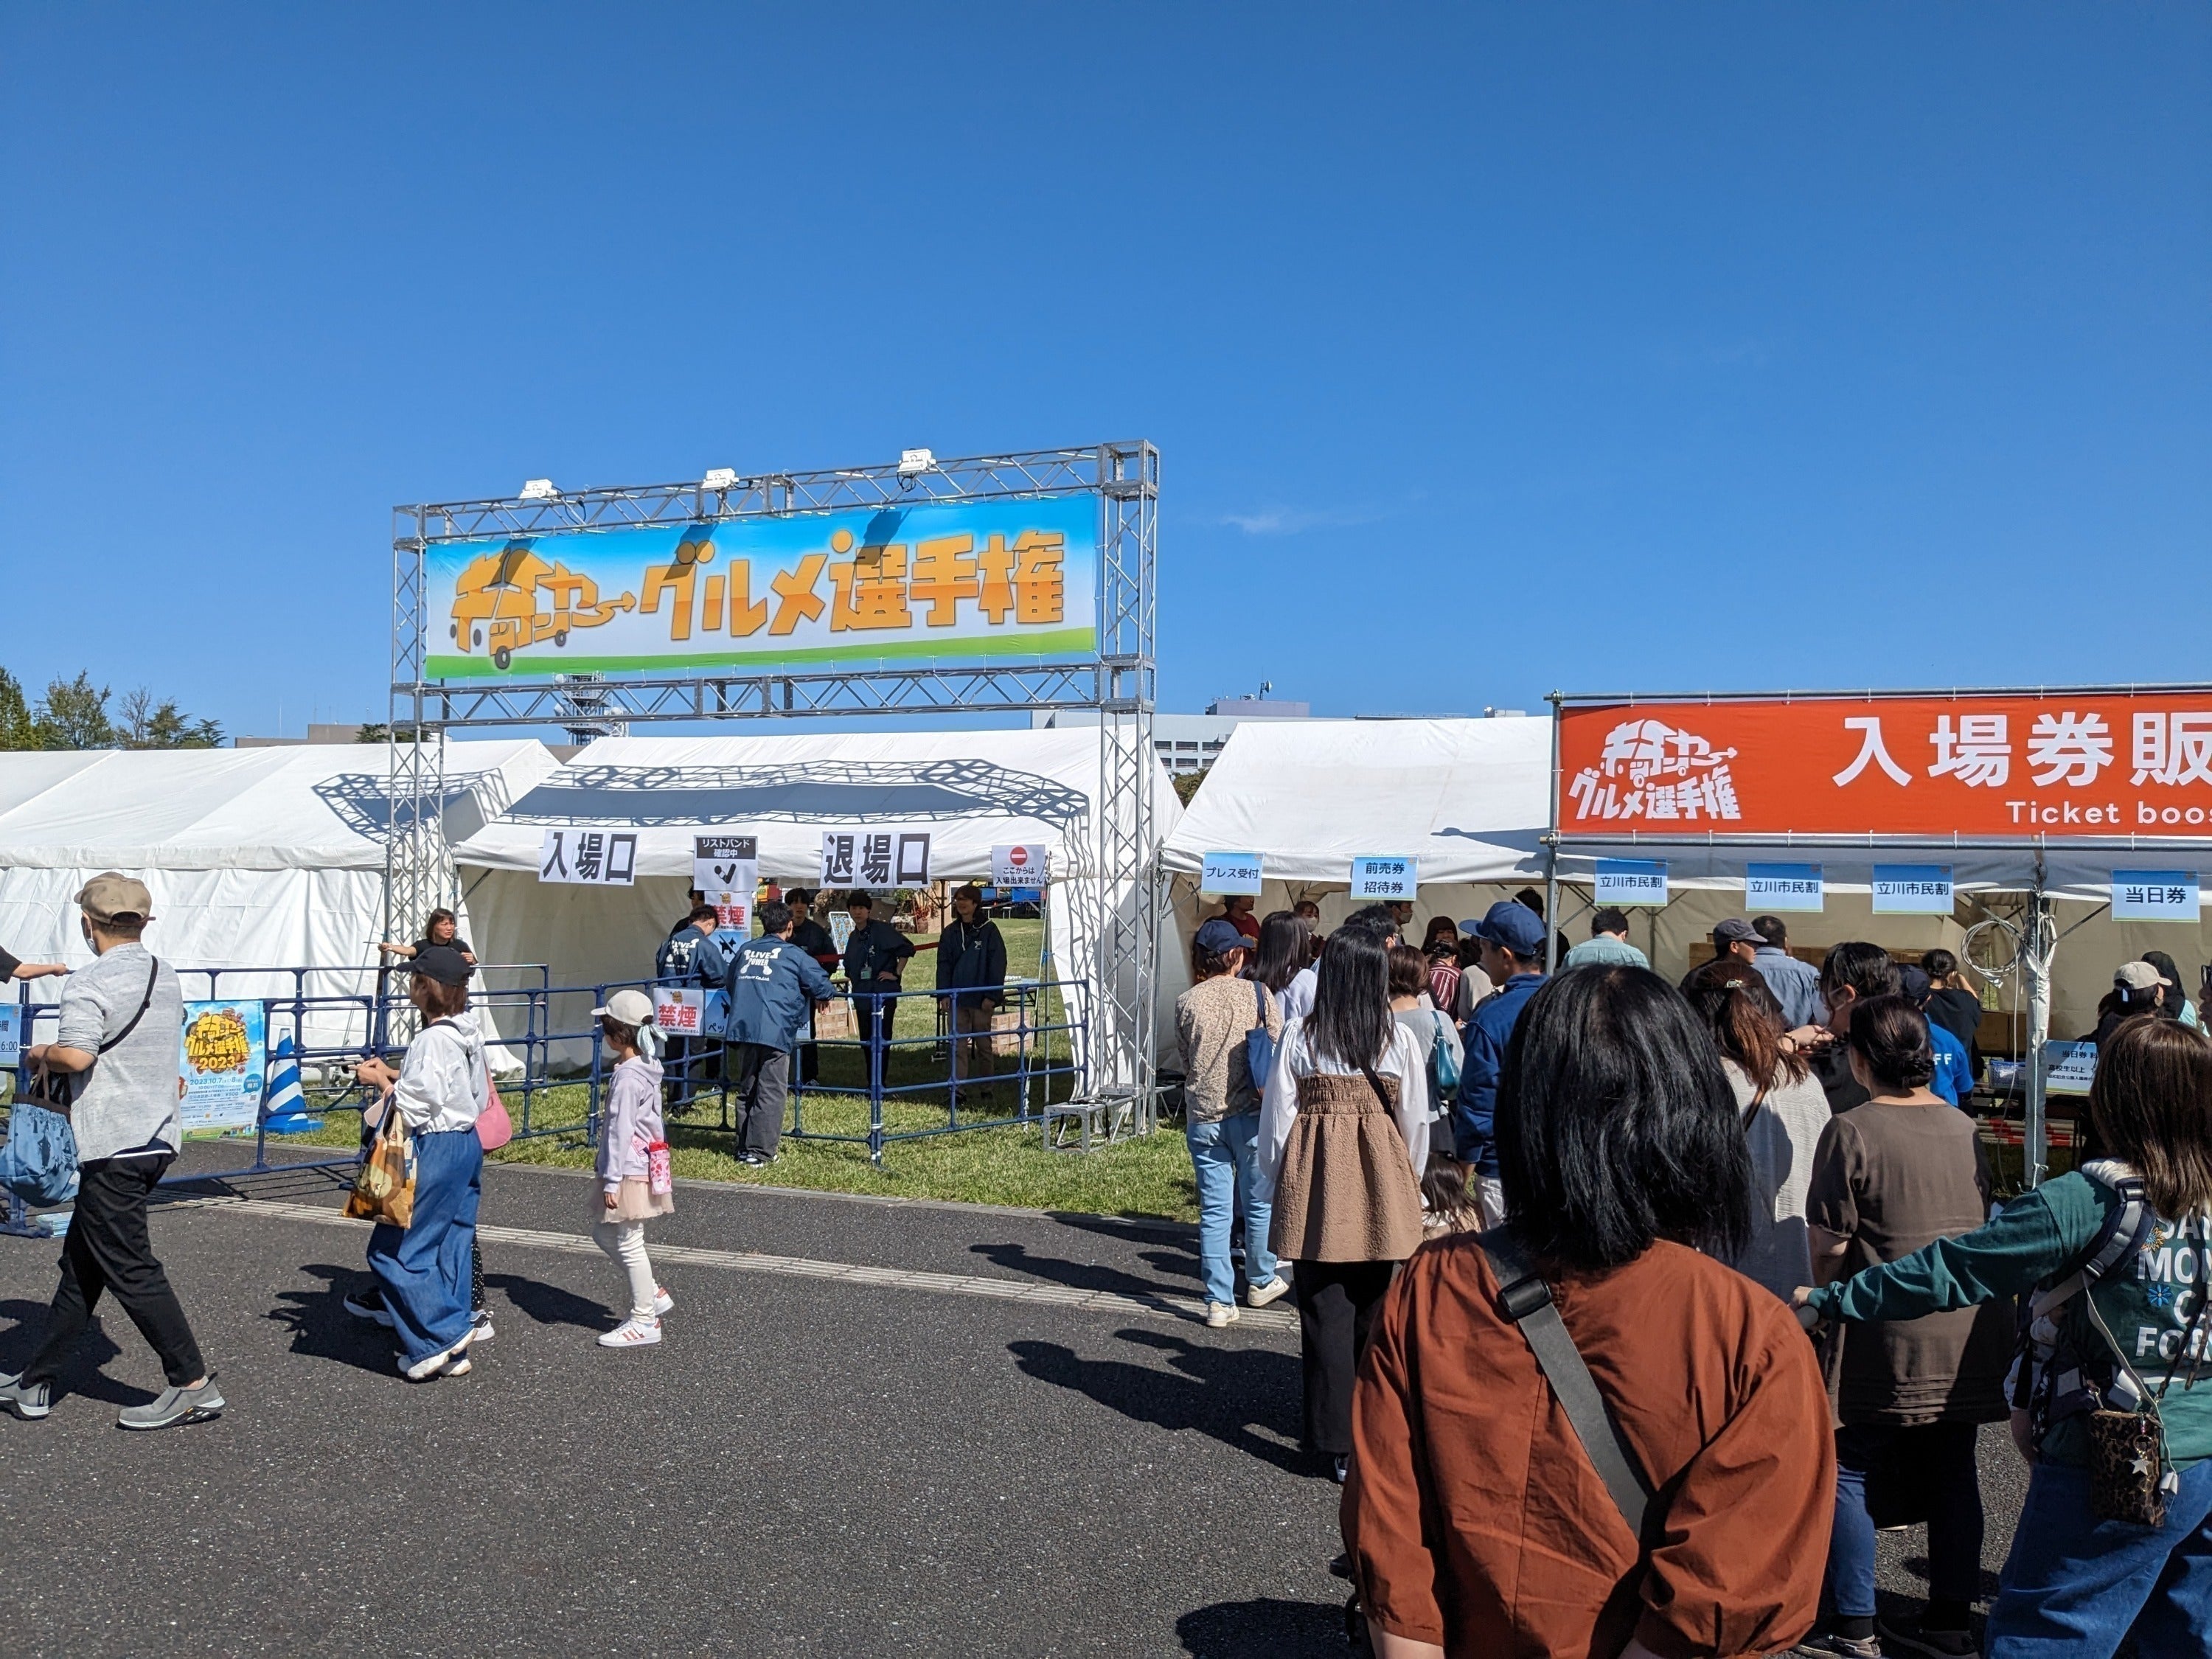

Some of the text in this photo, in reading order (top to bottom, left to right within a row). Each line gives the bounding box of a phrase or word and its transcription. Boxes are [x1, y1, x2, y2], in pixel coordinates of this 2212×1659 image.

[1832, 711, 2212, 787] 入場券販
[1568, 764, 1742, 820] グルメ選手権
[2006, 800, 2212, 824] Ticket boo
[703, 838, 750, 849] リストバンド
[543, 832, 638, 883] 入場口
[713, 848, 738, 858] 確認中
[824, 833, 931, 885] 退場口
[1003, 866, 1035, 874] ここからは
[1206, 866, 1259, 880] プレス受付
[1365, 862, 1405, 875] 前売券
[995, 876, 1043, 885] 入場出来ません
[1599, 876, 1663, 888] 立川市民割
[1750, 880, 1819, 894] 立川市民割
[1363, 881, 1404, 894] 招待券
[1877, 881, 1950, 896] 立川市民割
[2125, 886, 2187, 905] 当日券
[750, 950, 772, 959] LIVE
[748, 958, 769, 966] POWER
[658, 1004, 698, 1028] 禁煙
[0, 1020, 9, 1032] 間
[2062, 1050, 2087, 1059] 当日券
[199, 1056, 236, 1070] 2023
[2048, 1064, 2085, 1074] 高校生以上
